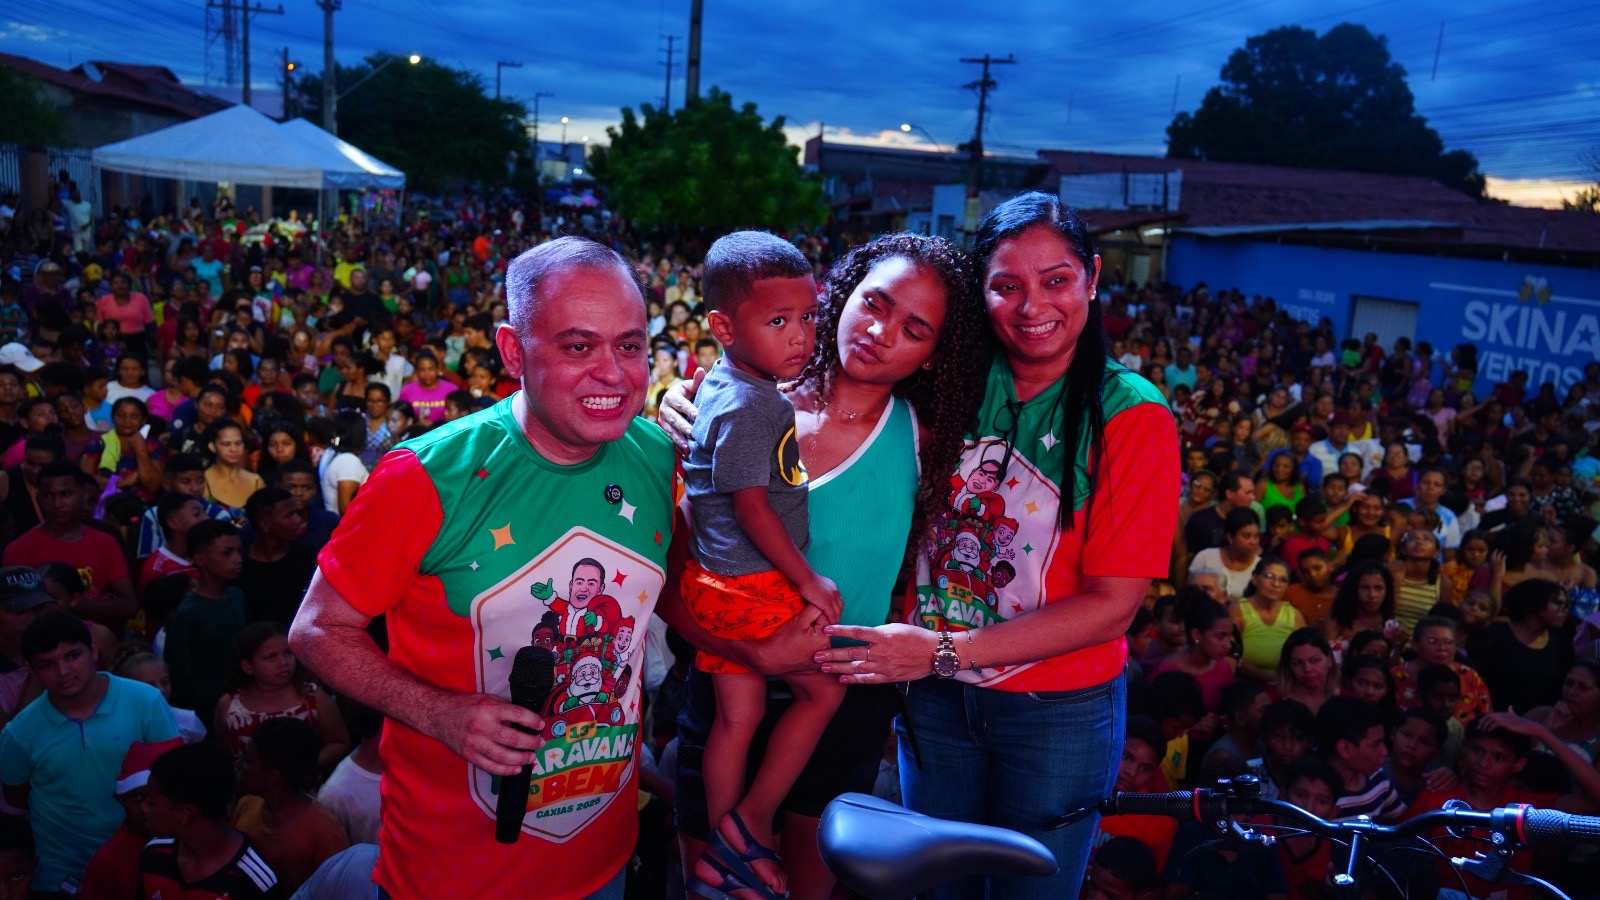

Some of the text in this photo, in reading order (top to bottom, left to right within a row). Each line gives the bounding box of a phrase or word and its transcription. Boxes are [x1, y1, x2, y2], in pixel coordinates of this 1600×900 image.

[1461, 299, 1600, 363] SKINA
[531, 733, 635, 776] ARAVANA
[542, 763, 619, 804] BEM
[535, 796, 602, 819] CAXIAS 2025
